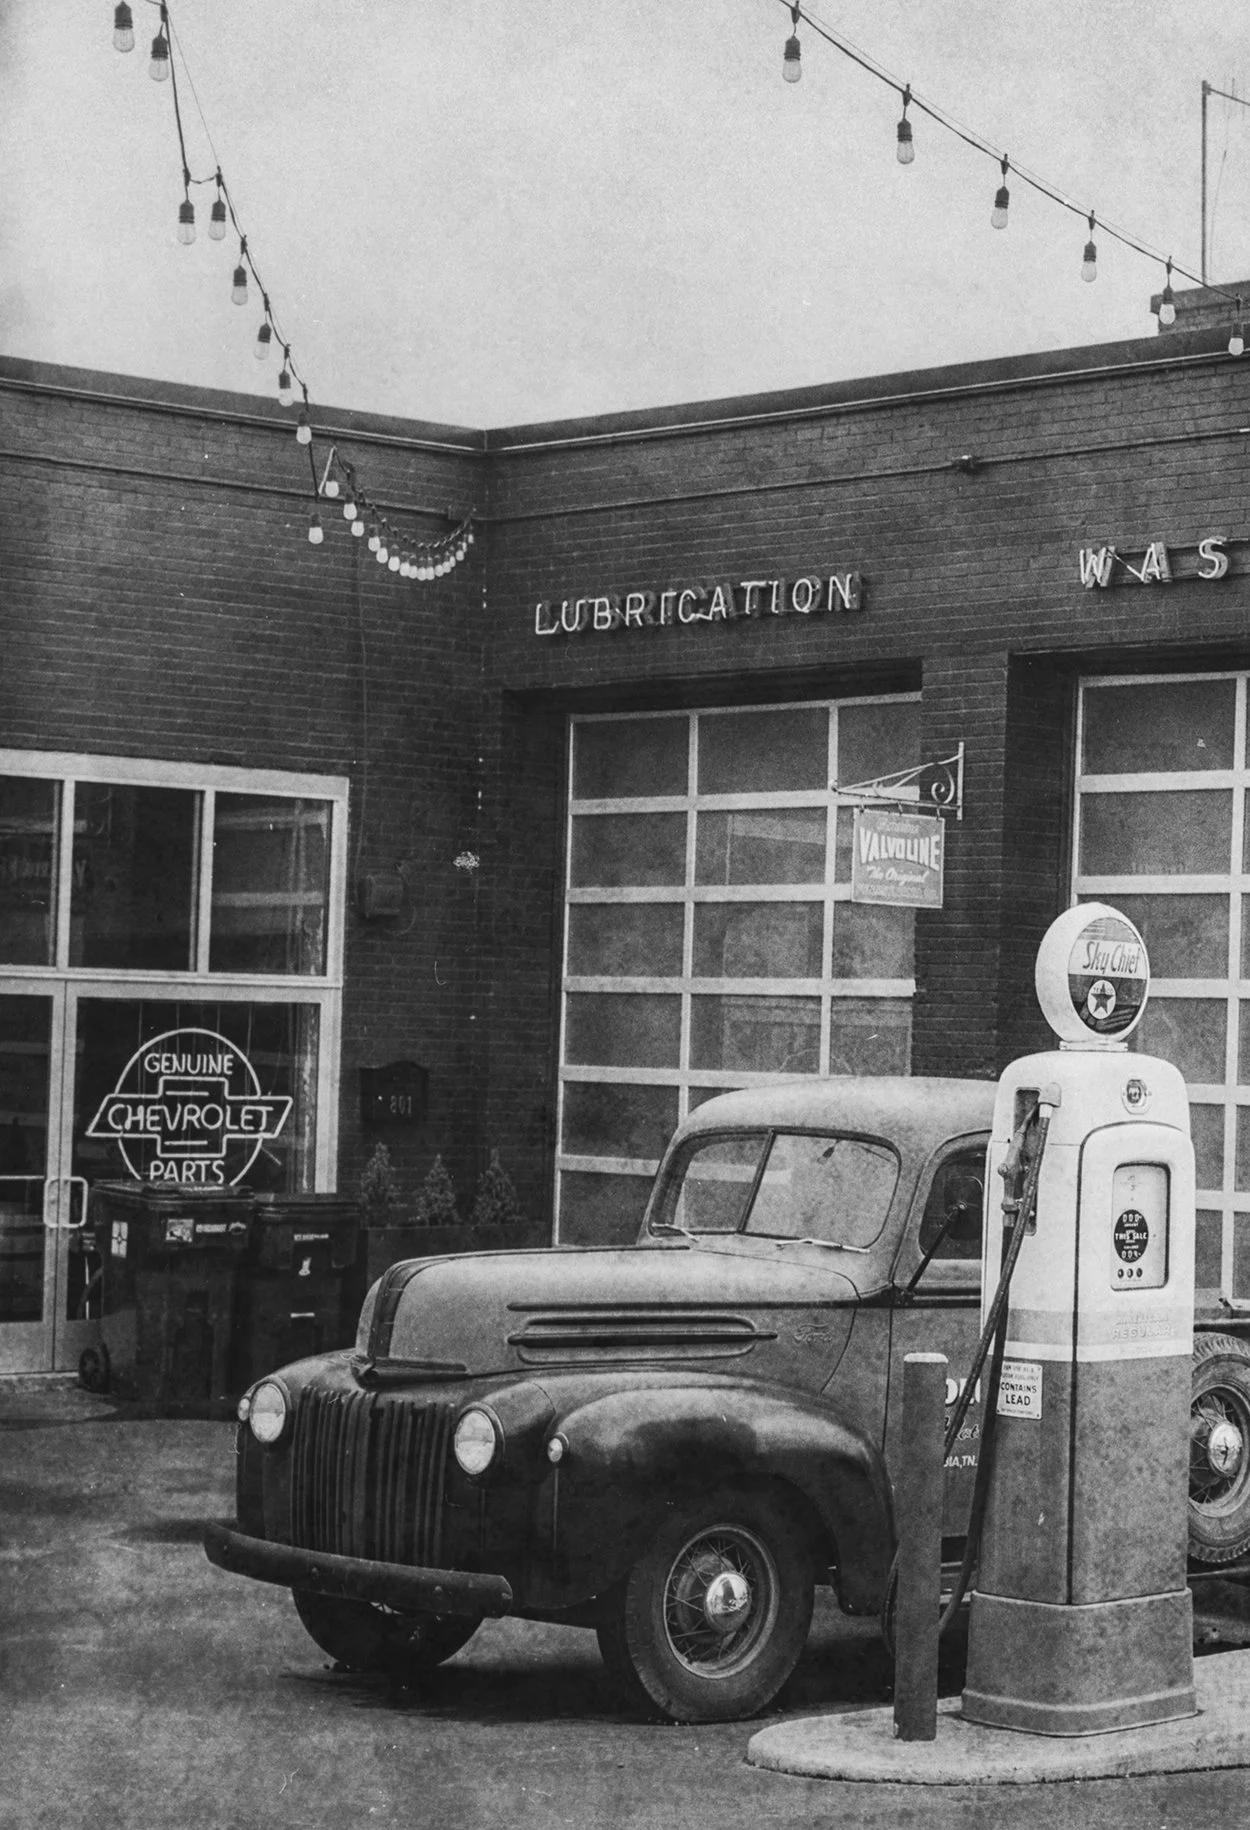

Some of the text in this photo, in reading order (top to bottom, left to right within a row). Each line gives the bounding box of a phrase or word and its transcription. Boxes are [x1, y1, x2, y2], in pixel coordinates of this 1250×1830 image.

[535, 570, 861, 634] LUBRICATION
[860, 826, 940, 872] VALVOLINE
[1082, 940, 1141, 974] Sky Chief
[144, 1053, 234, 1075] GENUINE
[107, 1104, 274, 1131] CHEVROLET
[150, 1160, 225, 1184] PARTS
[1001, 1382, 1037, 1393] CONTAINS
[1005, 1394, 1031, 1406] LEAD
